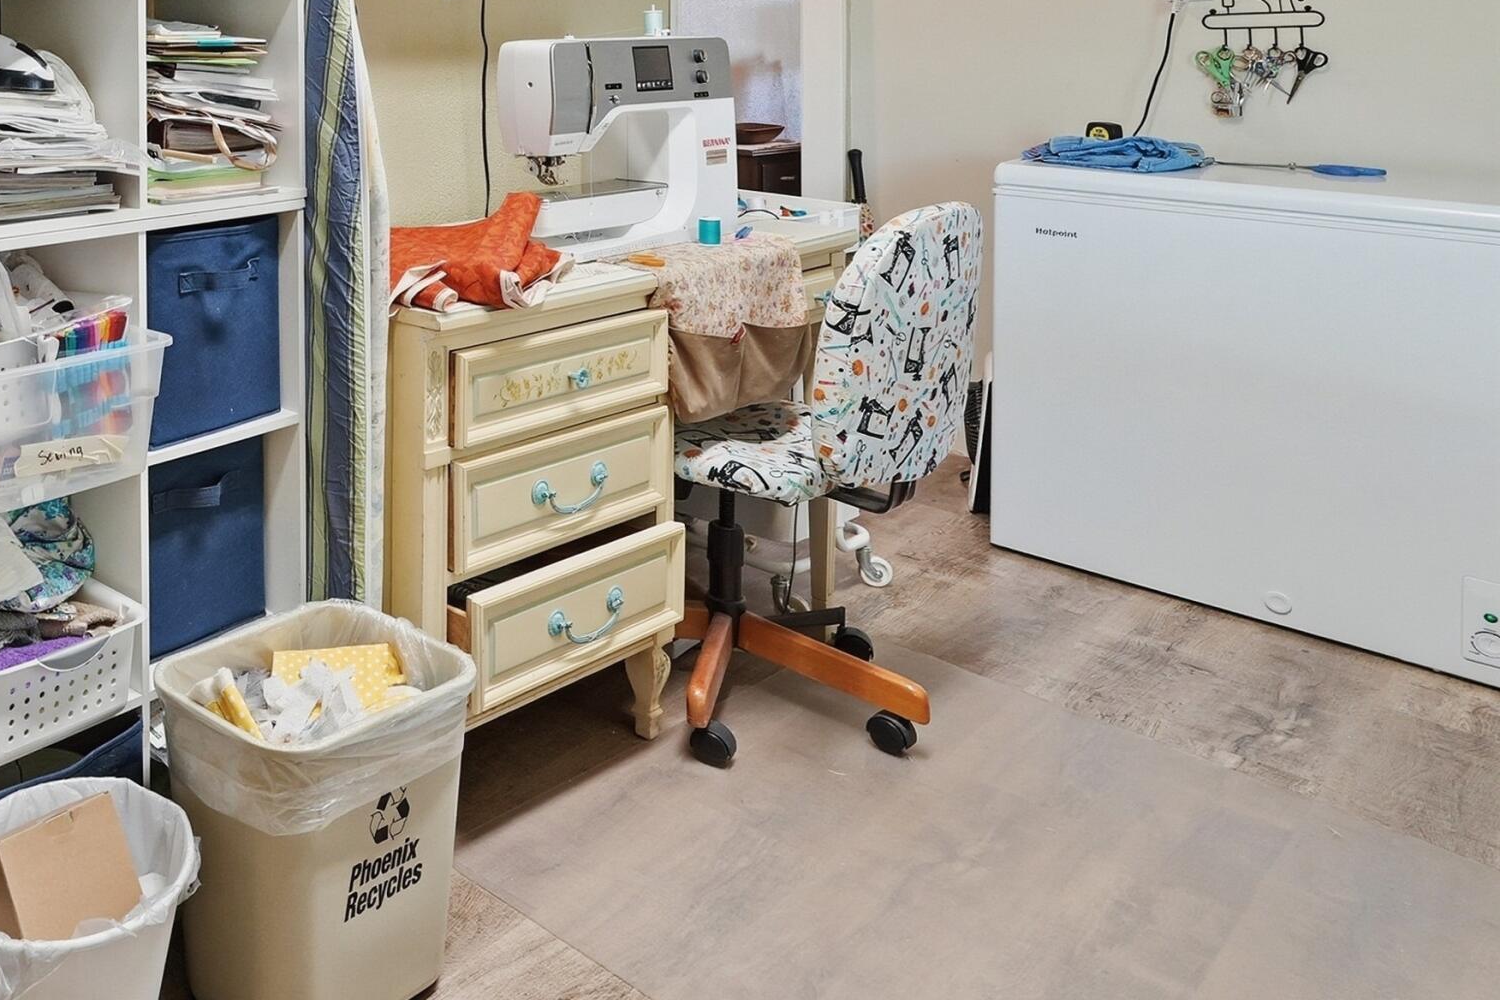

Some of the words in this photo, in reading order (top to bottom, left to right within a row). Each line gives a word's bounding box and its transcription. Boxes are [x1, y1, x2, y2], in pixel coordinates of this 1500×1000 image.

[1035, 227, 1078, 239] Hotpoint
[38, 446, 83, 466] Sewing
[348, 837, 420, 893] Phoenix
[344, 863, 423, 923] Recycles
